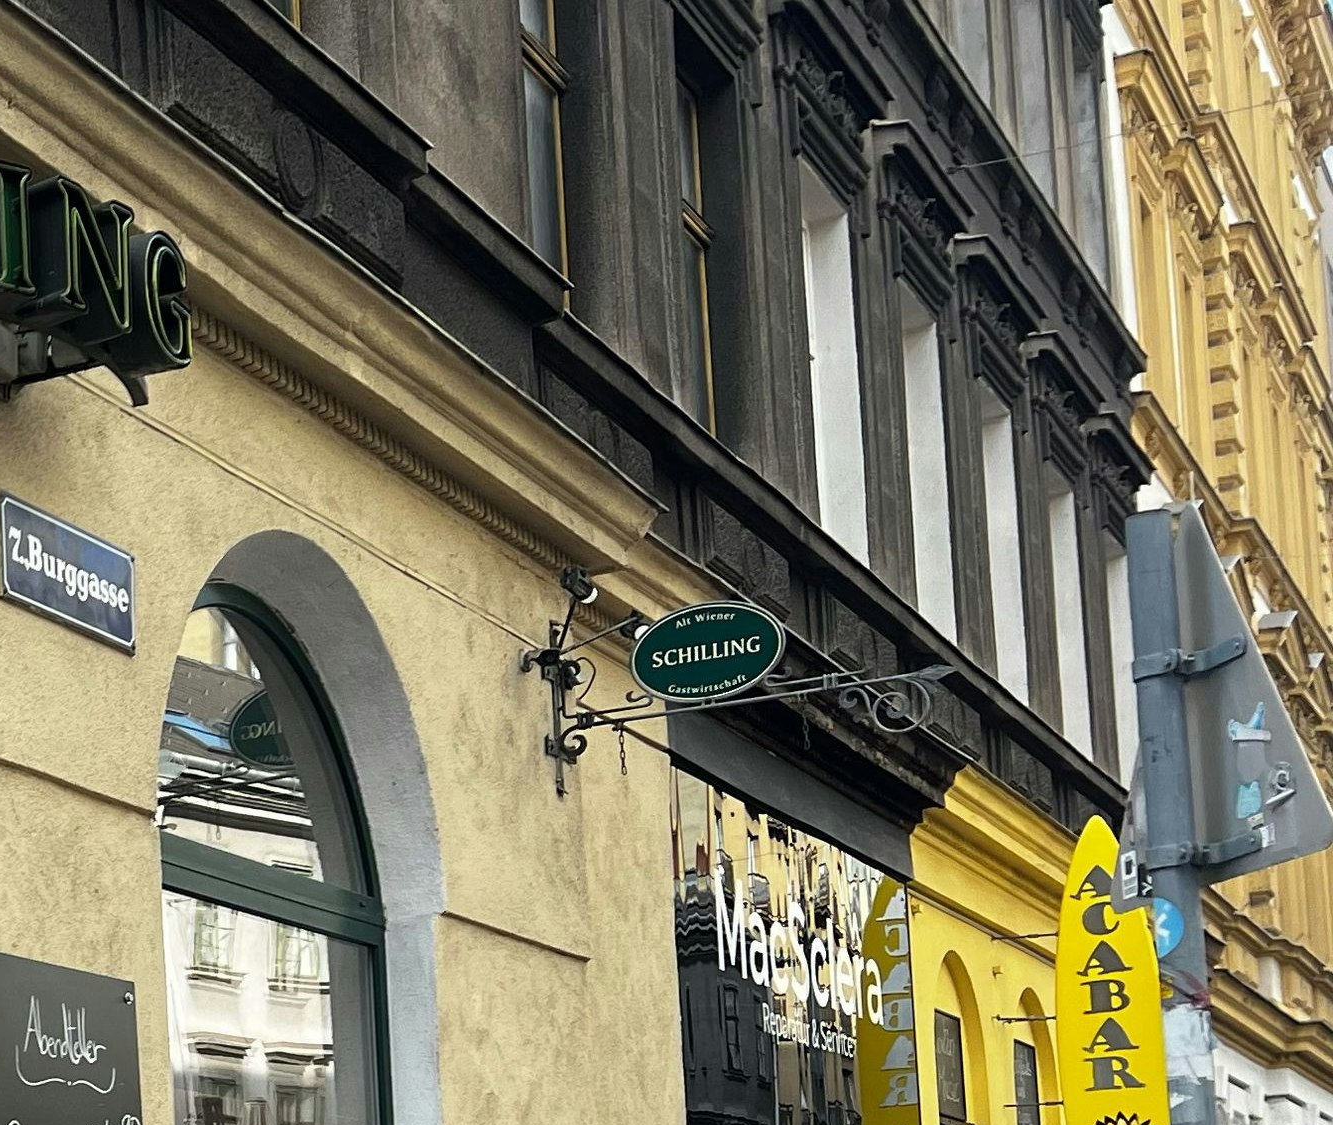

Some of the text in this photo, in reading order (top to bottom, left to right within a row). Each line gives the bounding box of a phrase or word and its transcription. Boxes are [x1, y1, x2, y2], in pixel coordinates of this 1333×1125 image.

[675, 611, 736, 629] Alt Wiener
[651, 636, 762, 669] SCHILLING
[667, 674, 748, 695] Gastwirtschaft
[1069, 864, 1147, 1093] ACABAR
